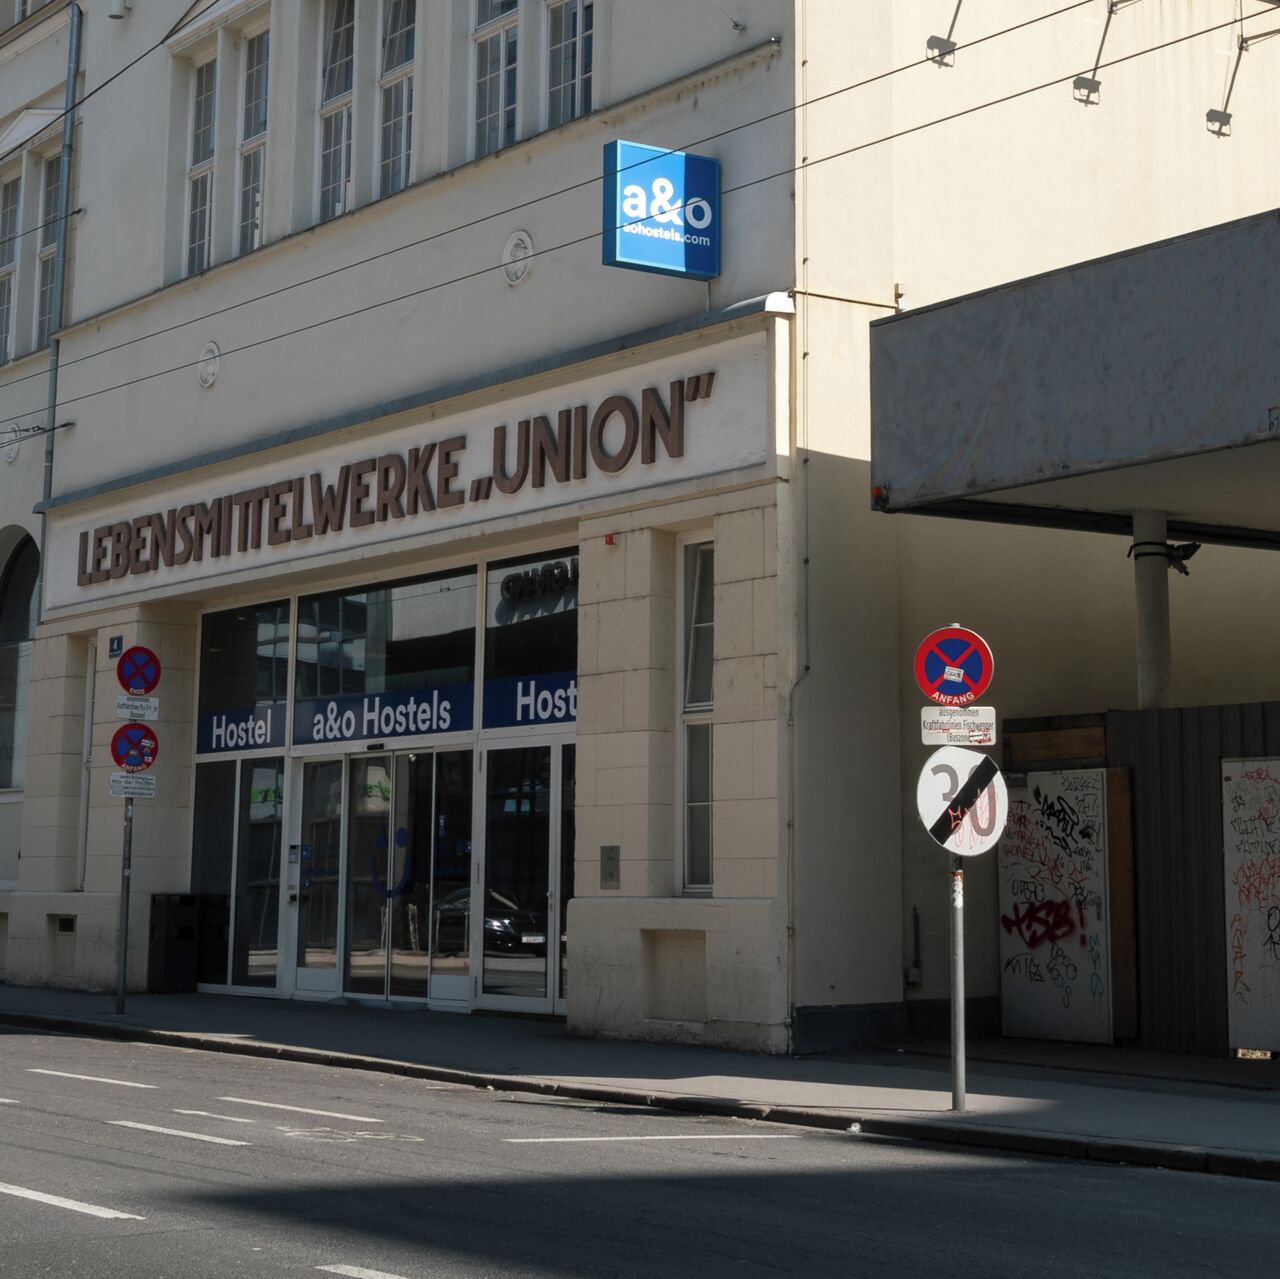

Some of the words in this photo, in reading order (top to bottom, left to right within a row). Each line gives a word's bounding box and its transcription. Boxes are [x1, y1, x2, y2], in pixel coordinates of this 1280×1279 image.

[622, 177, 713, 230] a&o
[623, 222, 711, 247] aohostels.com
[76, 435, 467, 587] LEBENSMITTELWERKE
[312, 701, 356, 741] a&o
[362, 689, 452, 736] Hostels
[931, 691, 975, 705] ANFANG
[211, 709, 272, 749] Hostel
[121, 762, 148, 771] ANFANG
[930, 762, 997, 838] 30
